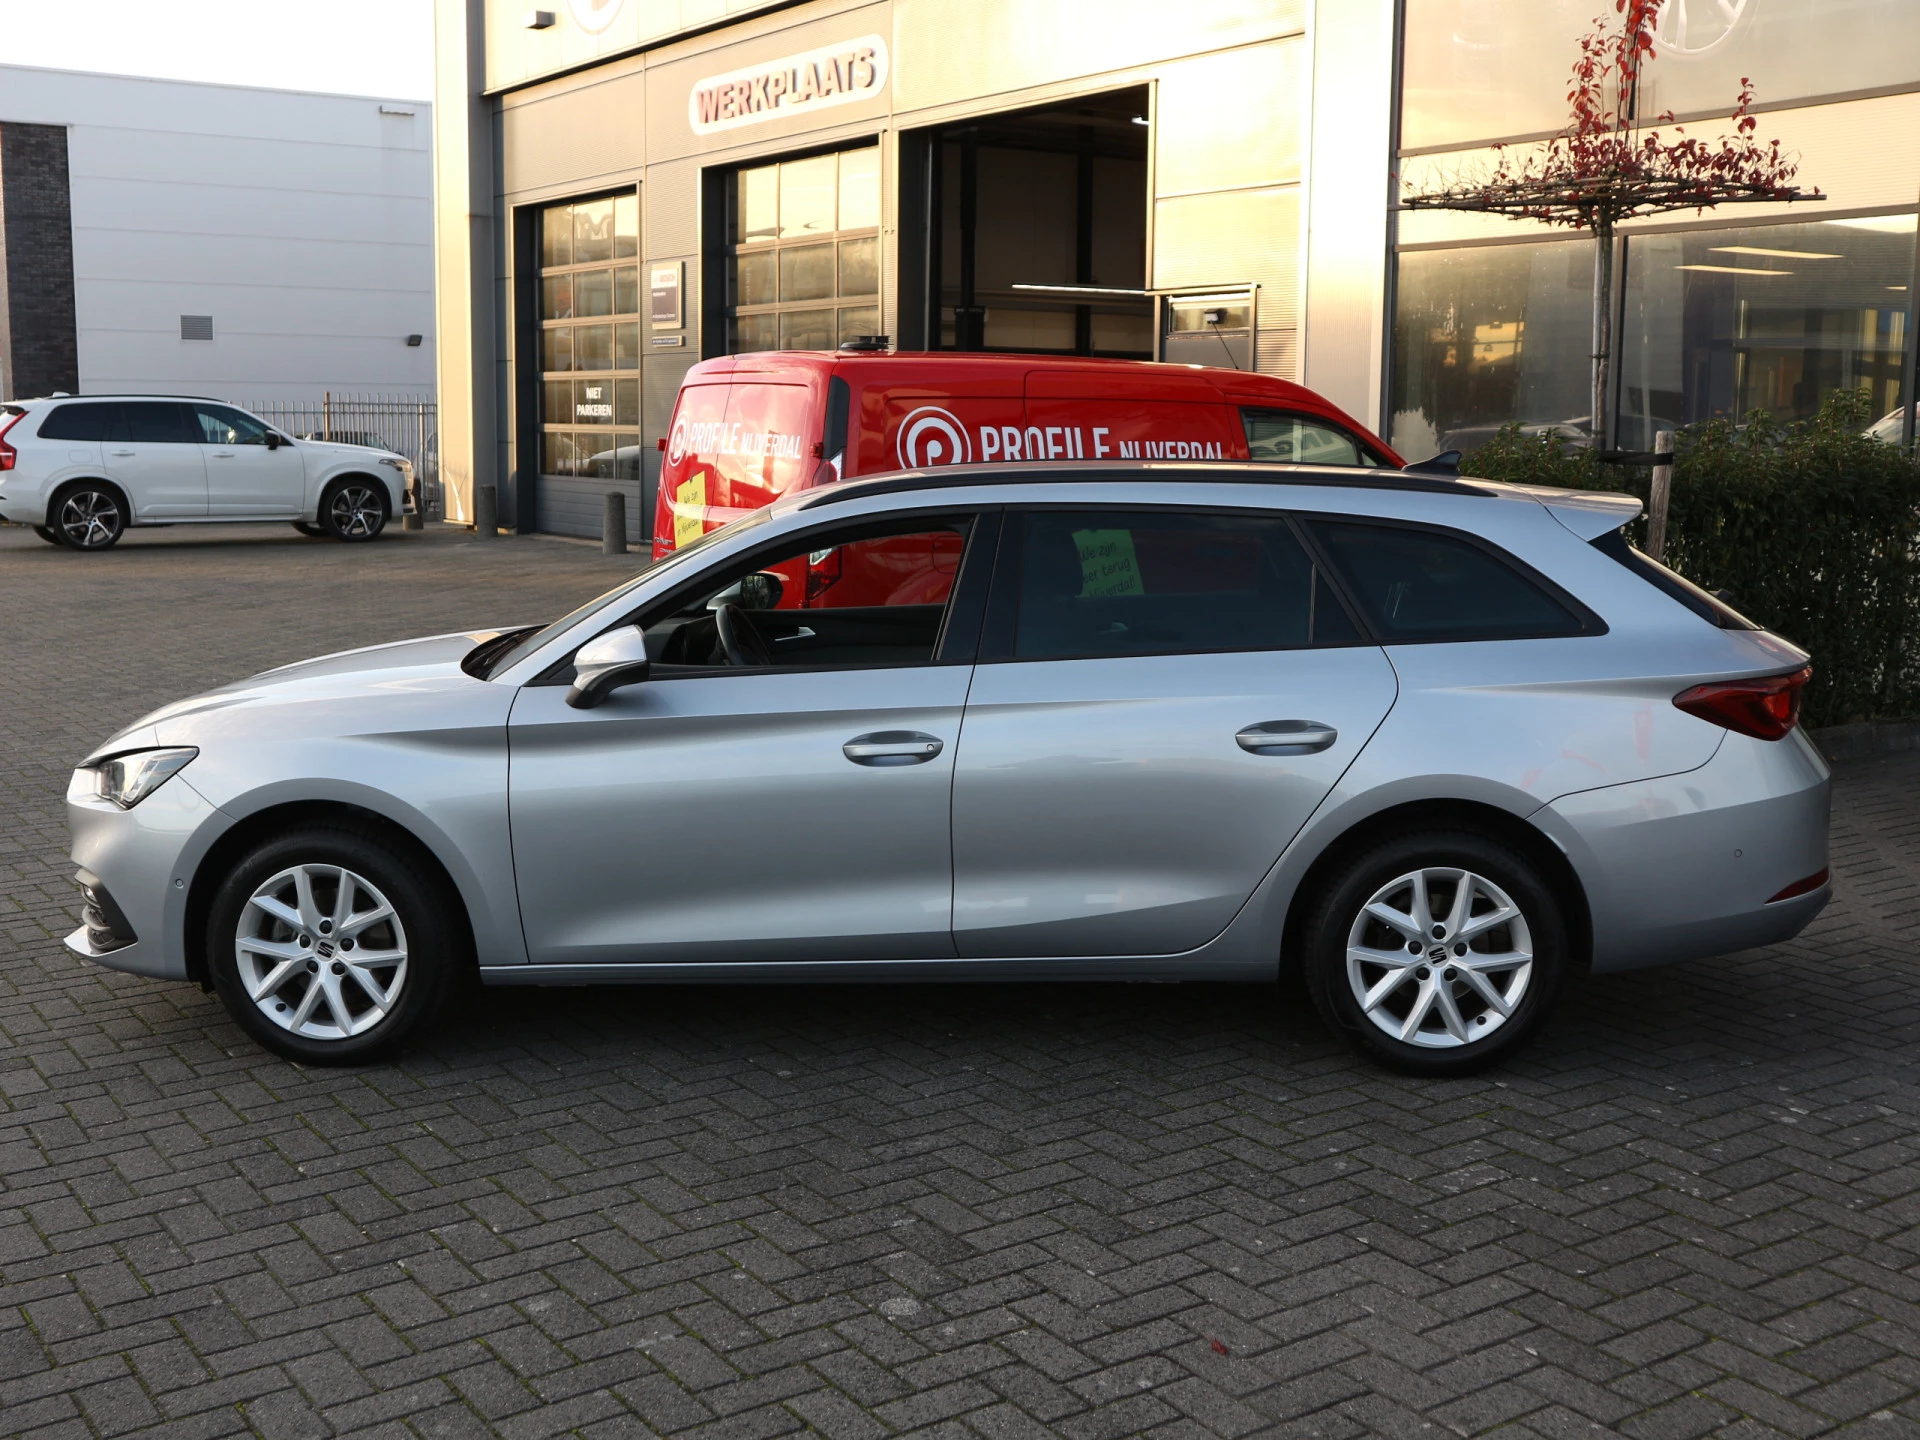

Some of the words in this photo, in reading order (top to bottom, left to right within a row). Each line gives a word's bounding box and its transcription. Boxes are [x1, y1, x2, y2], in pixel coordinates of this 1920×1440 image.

[697, 48, 876, 123] WERKPLAATS
[586, 387, 602, 399] NIET
[577, 404, 612, 416] PARKEREN
[688, 422, 741, 455] PROFILE
[980, 426, 1110, 462] PROFILE
